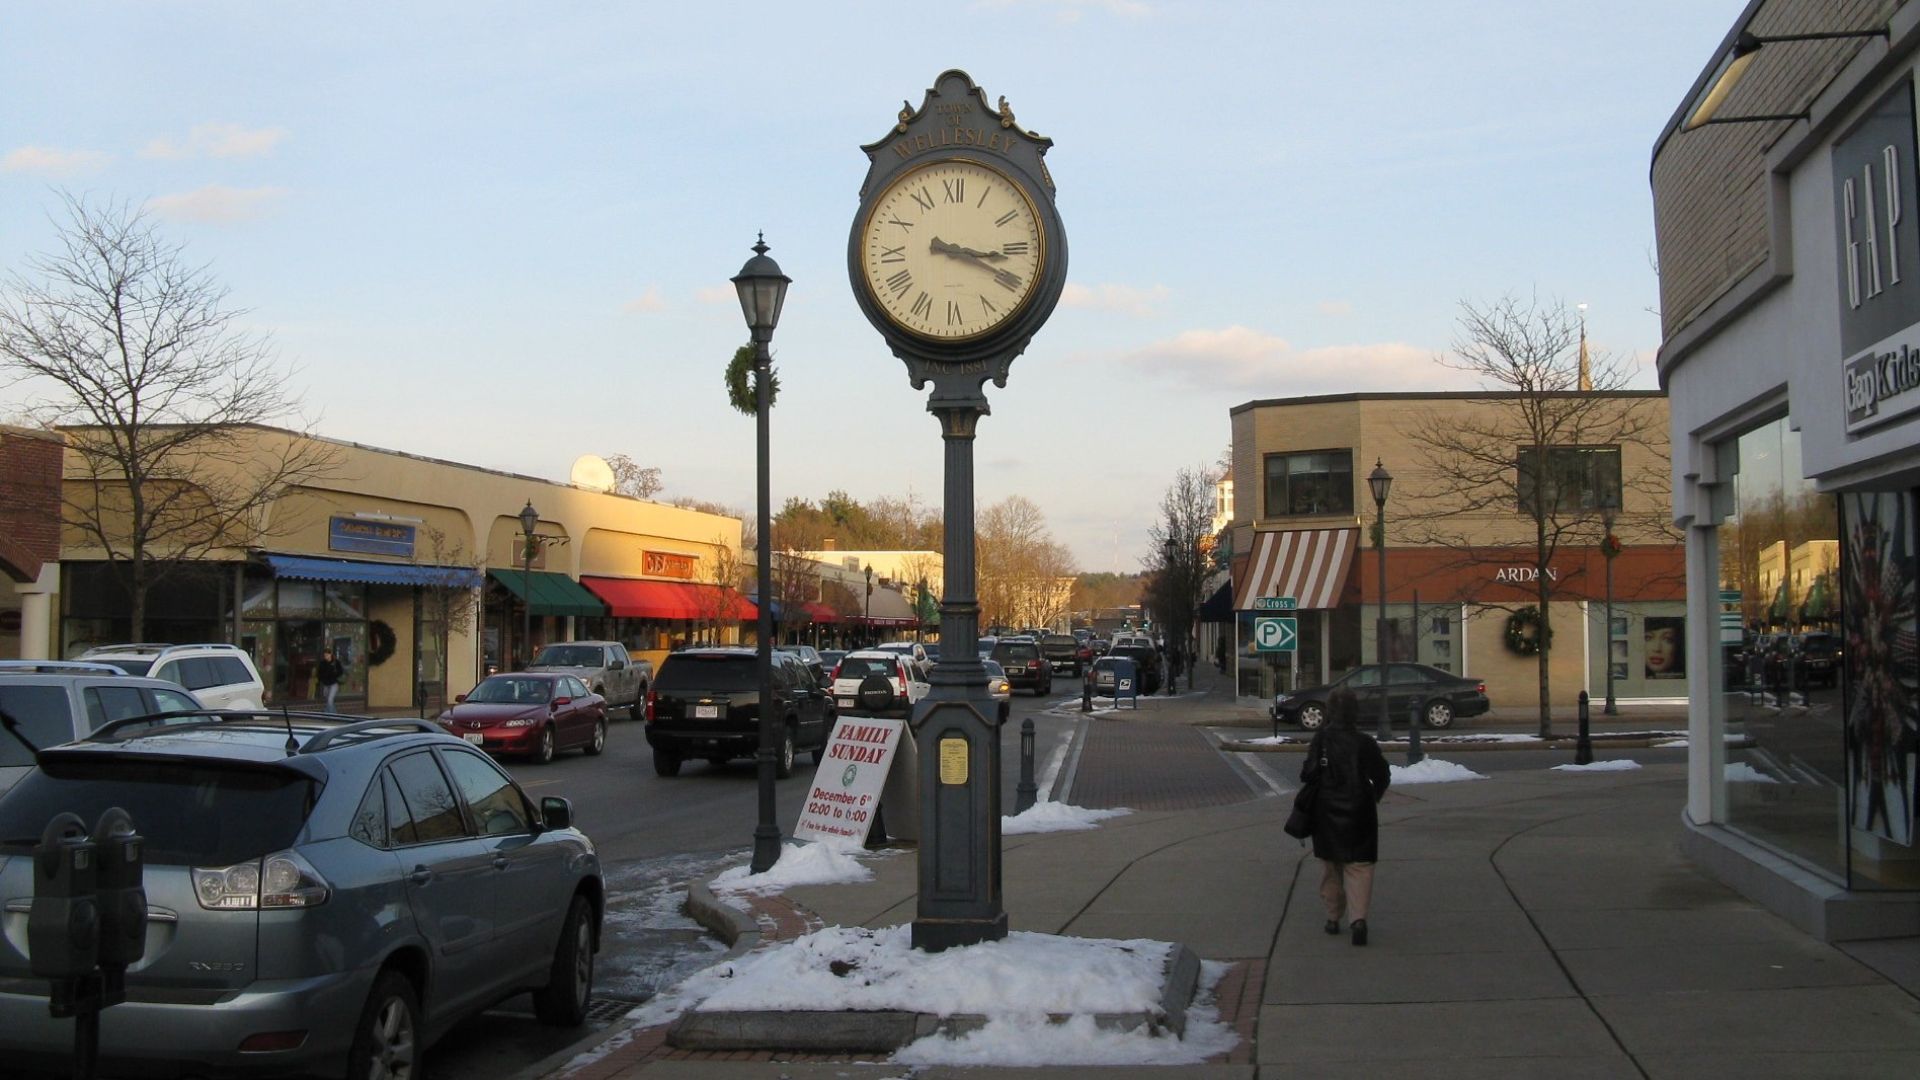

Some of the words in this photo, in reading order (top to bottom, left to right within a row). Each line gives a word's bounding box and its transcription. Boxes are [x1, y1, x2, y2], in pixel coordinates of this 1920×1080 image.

[894, 127, 1017, 159] WELLESLEY
[1843, 144, 1900, 311] GAP
[1845, 344, 1920, 417] GapKids
[1496, 567, 1557, 582] ARDAN
[1266, 599, 1288, 608] Cross
[1263, 624, 1277, 644] P
[836, 725, 892, 744] FAMILY
[829, 743, 887, 764] SUNDAY
[812, 787, 857, 805] December
[808, 802, 831, 816] 12:00
[833, 807, 842, 819] to
